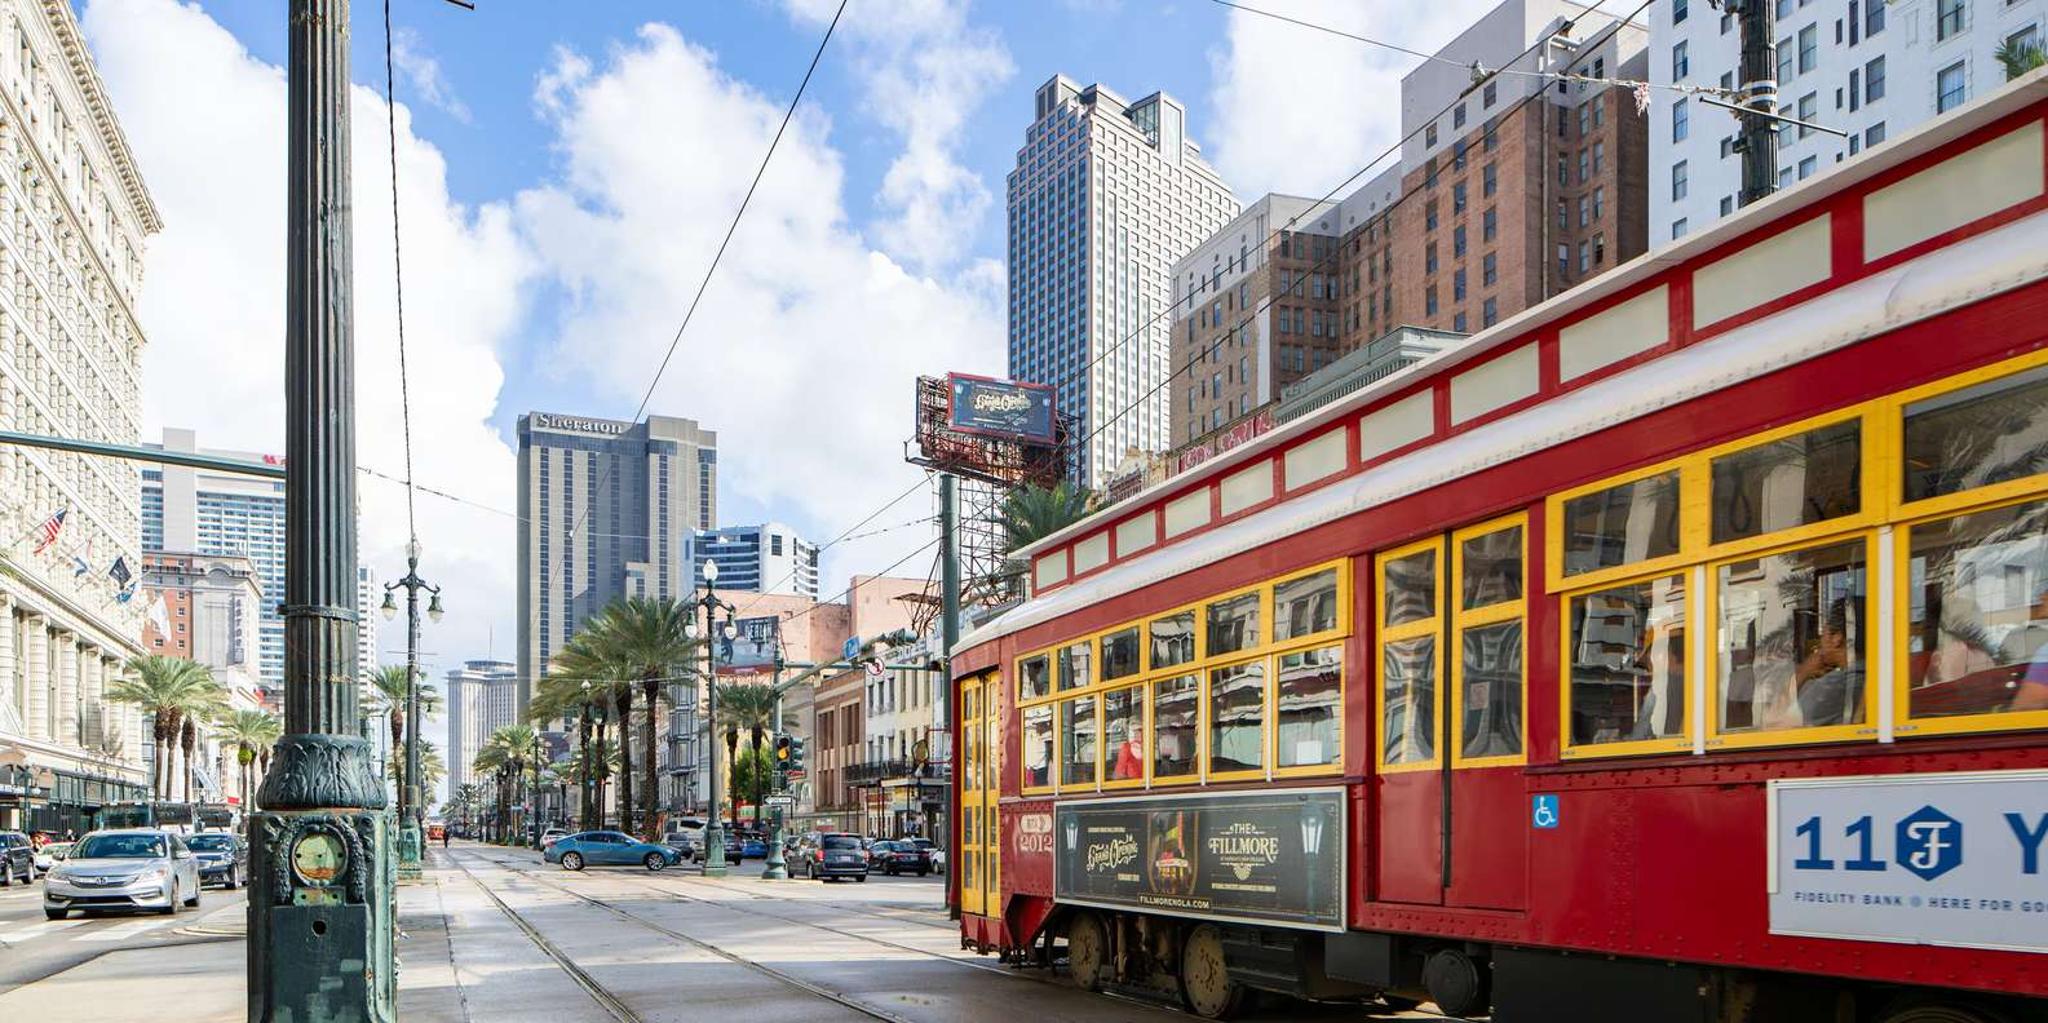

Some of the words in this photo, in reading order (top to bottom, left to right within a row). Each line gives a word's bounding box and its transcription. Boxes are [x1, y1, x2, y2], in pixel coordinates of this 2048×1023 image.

[539, 413, 622, 434] Sheraton
[1234, 823, 1252, 834] THE
[1020, 834, 1053, 852] 2012
[1208, 837, 1279, 863] FILLMORE
[1794, 891, 1855, 904] FIDELITY
[1863, 894, 1903, 907] BANK
[1928, 897, 1972, 909] HERE
[1979, 899, 2012, 911] FOR
[2020, 901, 2048, 913] GO
